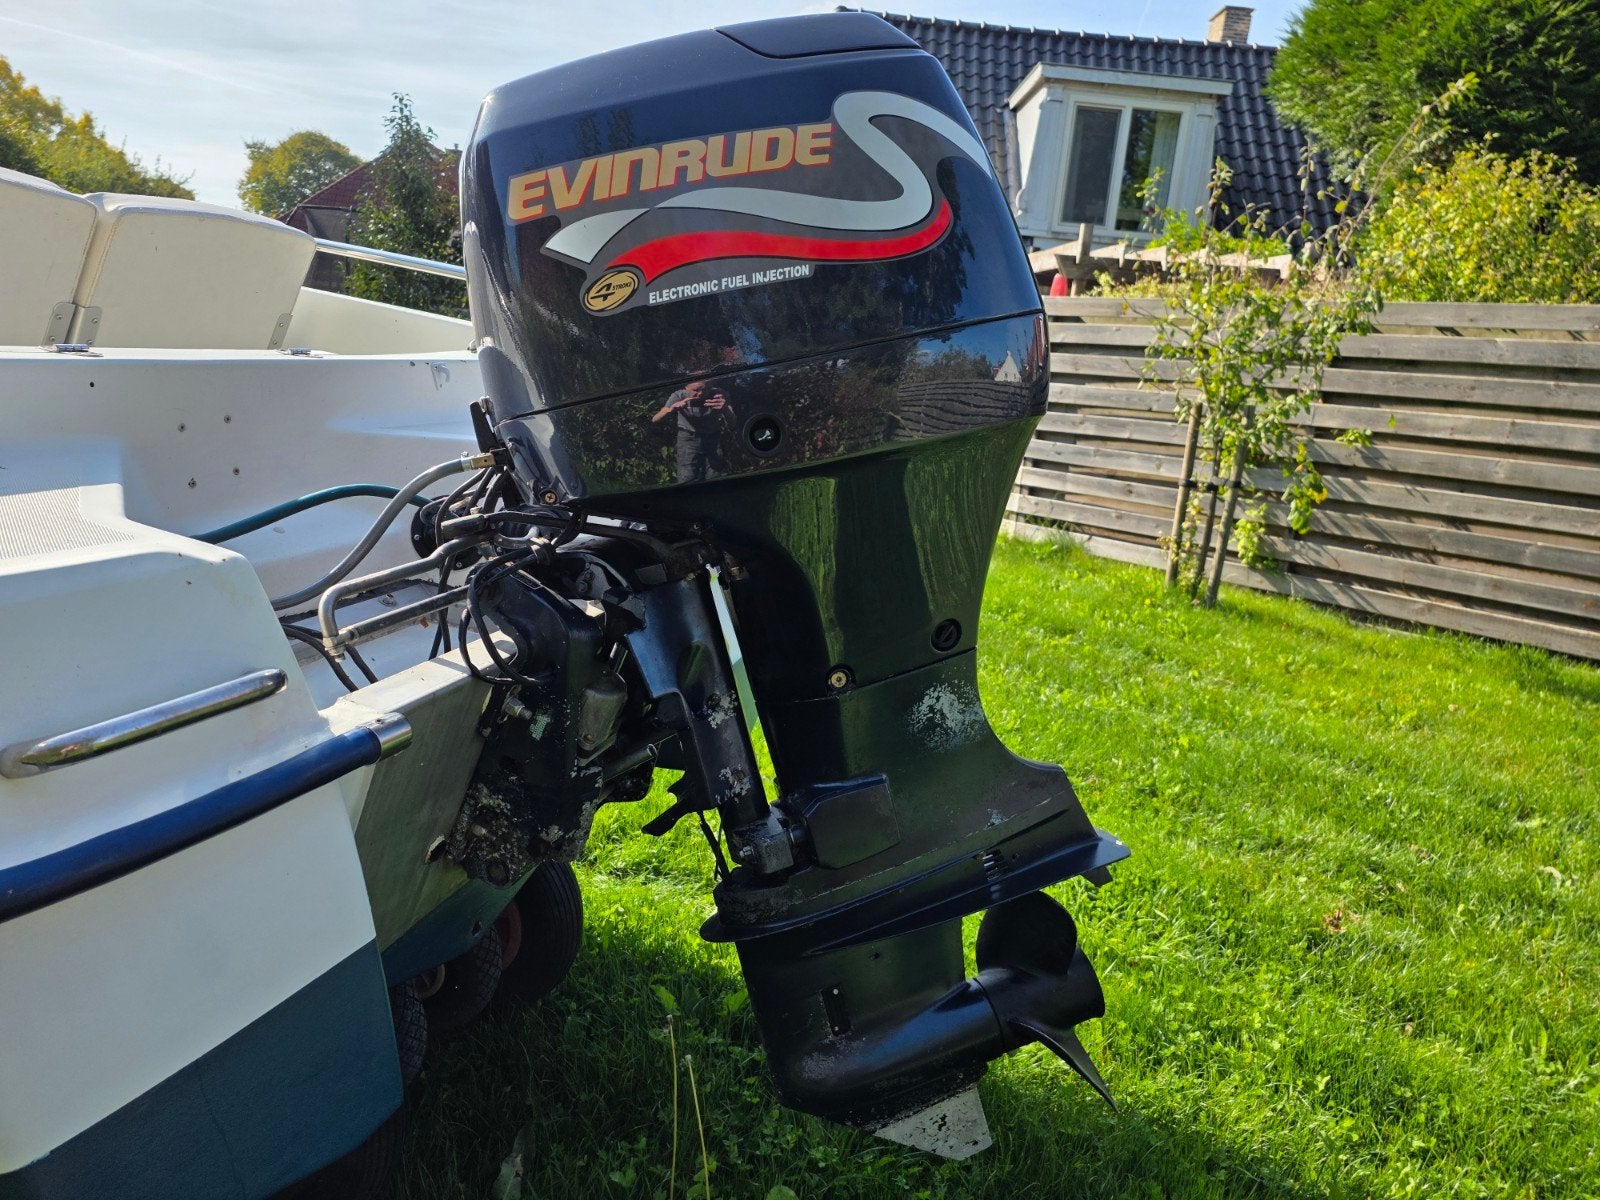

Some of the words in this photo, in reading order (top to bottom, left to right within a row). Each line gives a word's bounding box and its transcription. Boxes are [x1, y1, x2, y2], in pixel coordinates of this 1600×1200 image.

[508, 123, 833, 221] EVINRUDE
[590, 282, 616, 302] 4
[649, 279, 719, 304] ELECTRONIC
[721, 273, 750, 291] FUEL
[752, 264, 810, 285] INJECTION
